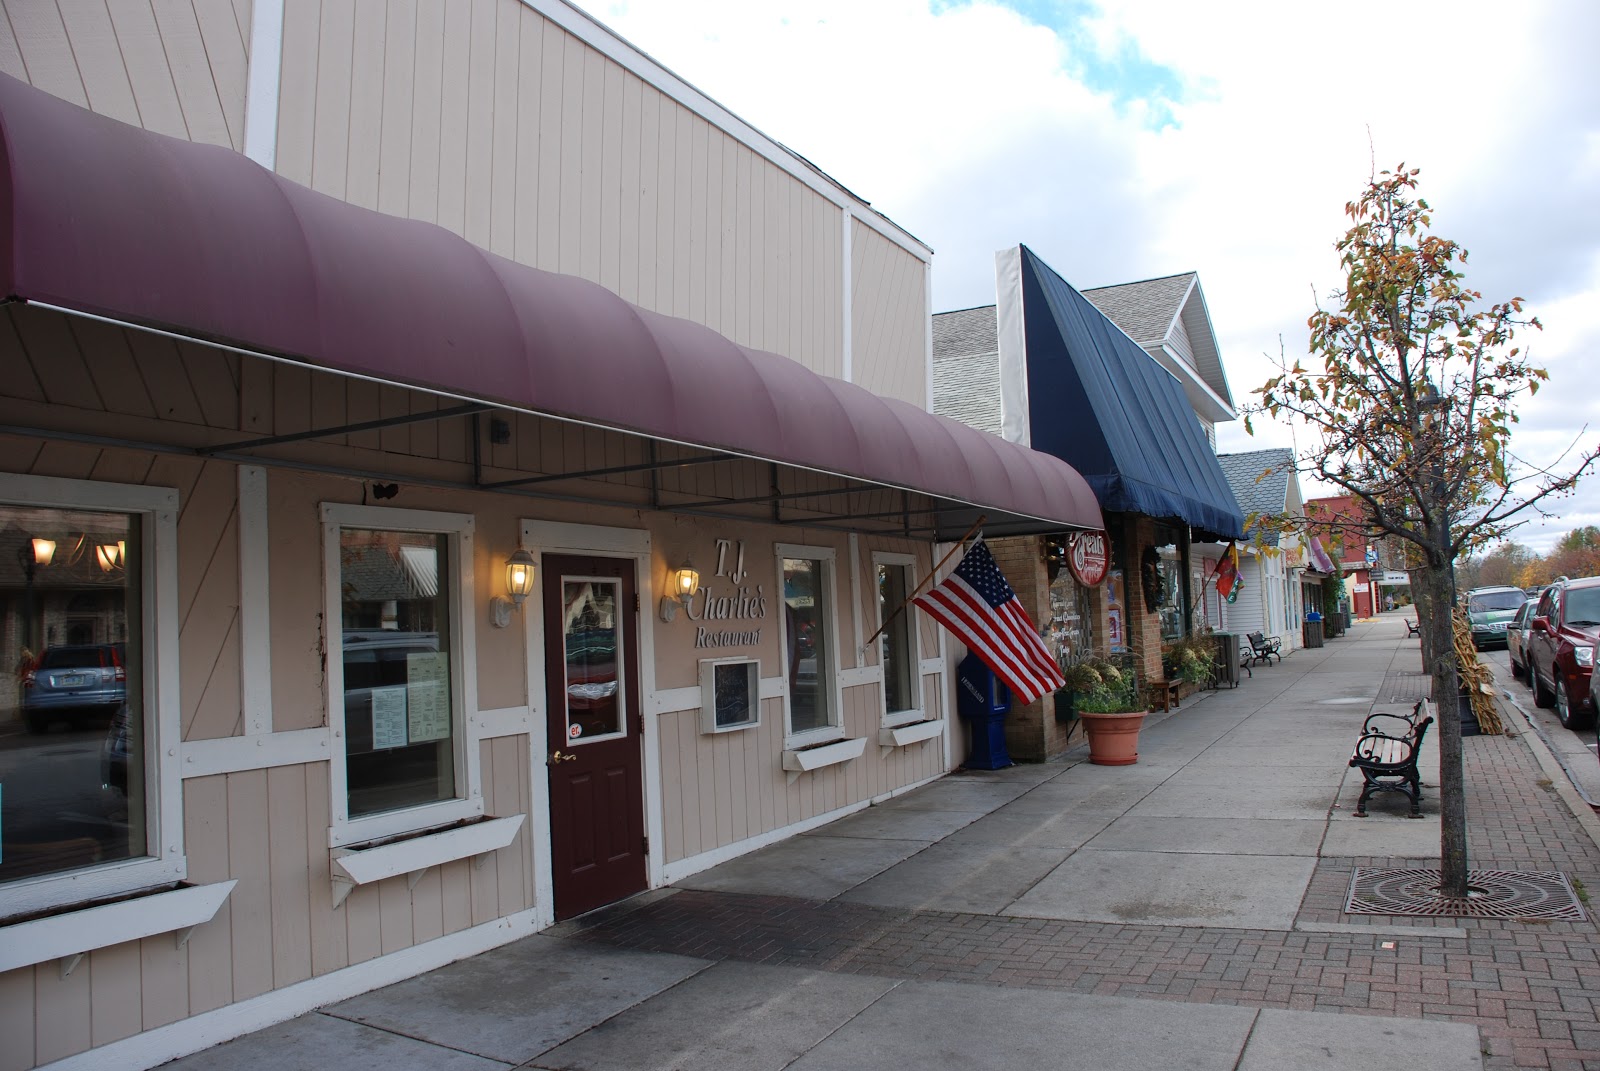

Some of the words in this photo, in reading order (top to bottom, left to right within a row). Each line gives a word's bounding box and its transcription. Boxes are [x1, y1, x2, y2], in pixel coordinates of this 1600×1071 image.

[715, 538, 747, 584] T.J.
[686, 585, 767, 620] Charlie's
[694, 626, 762, 648] Restaurant
